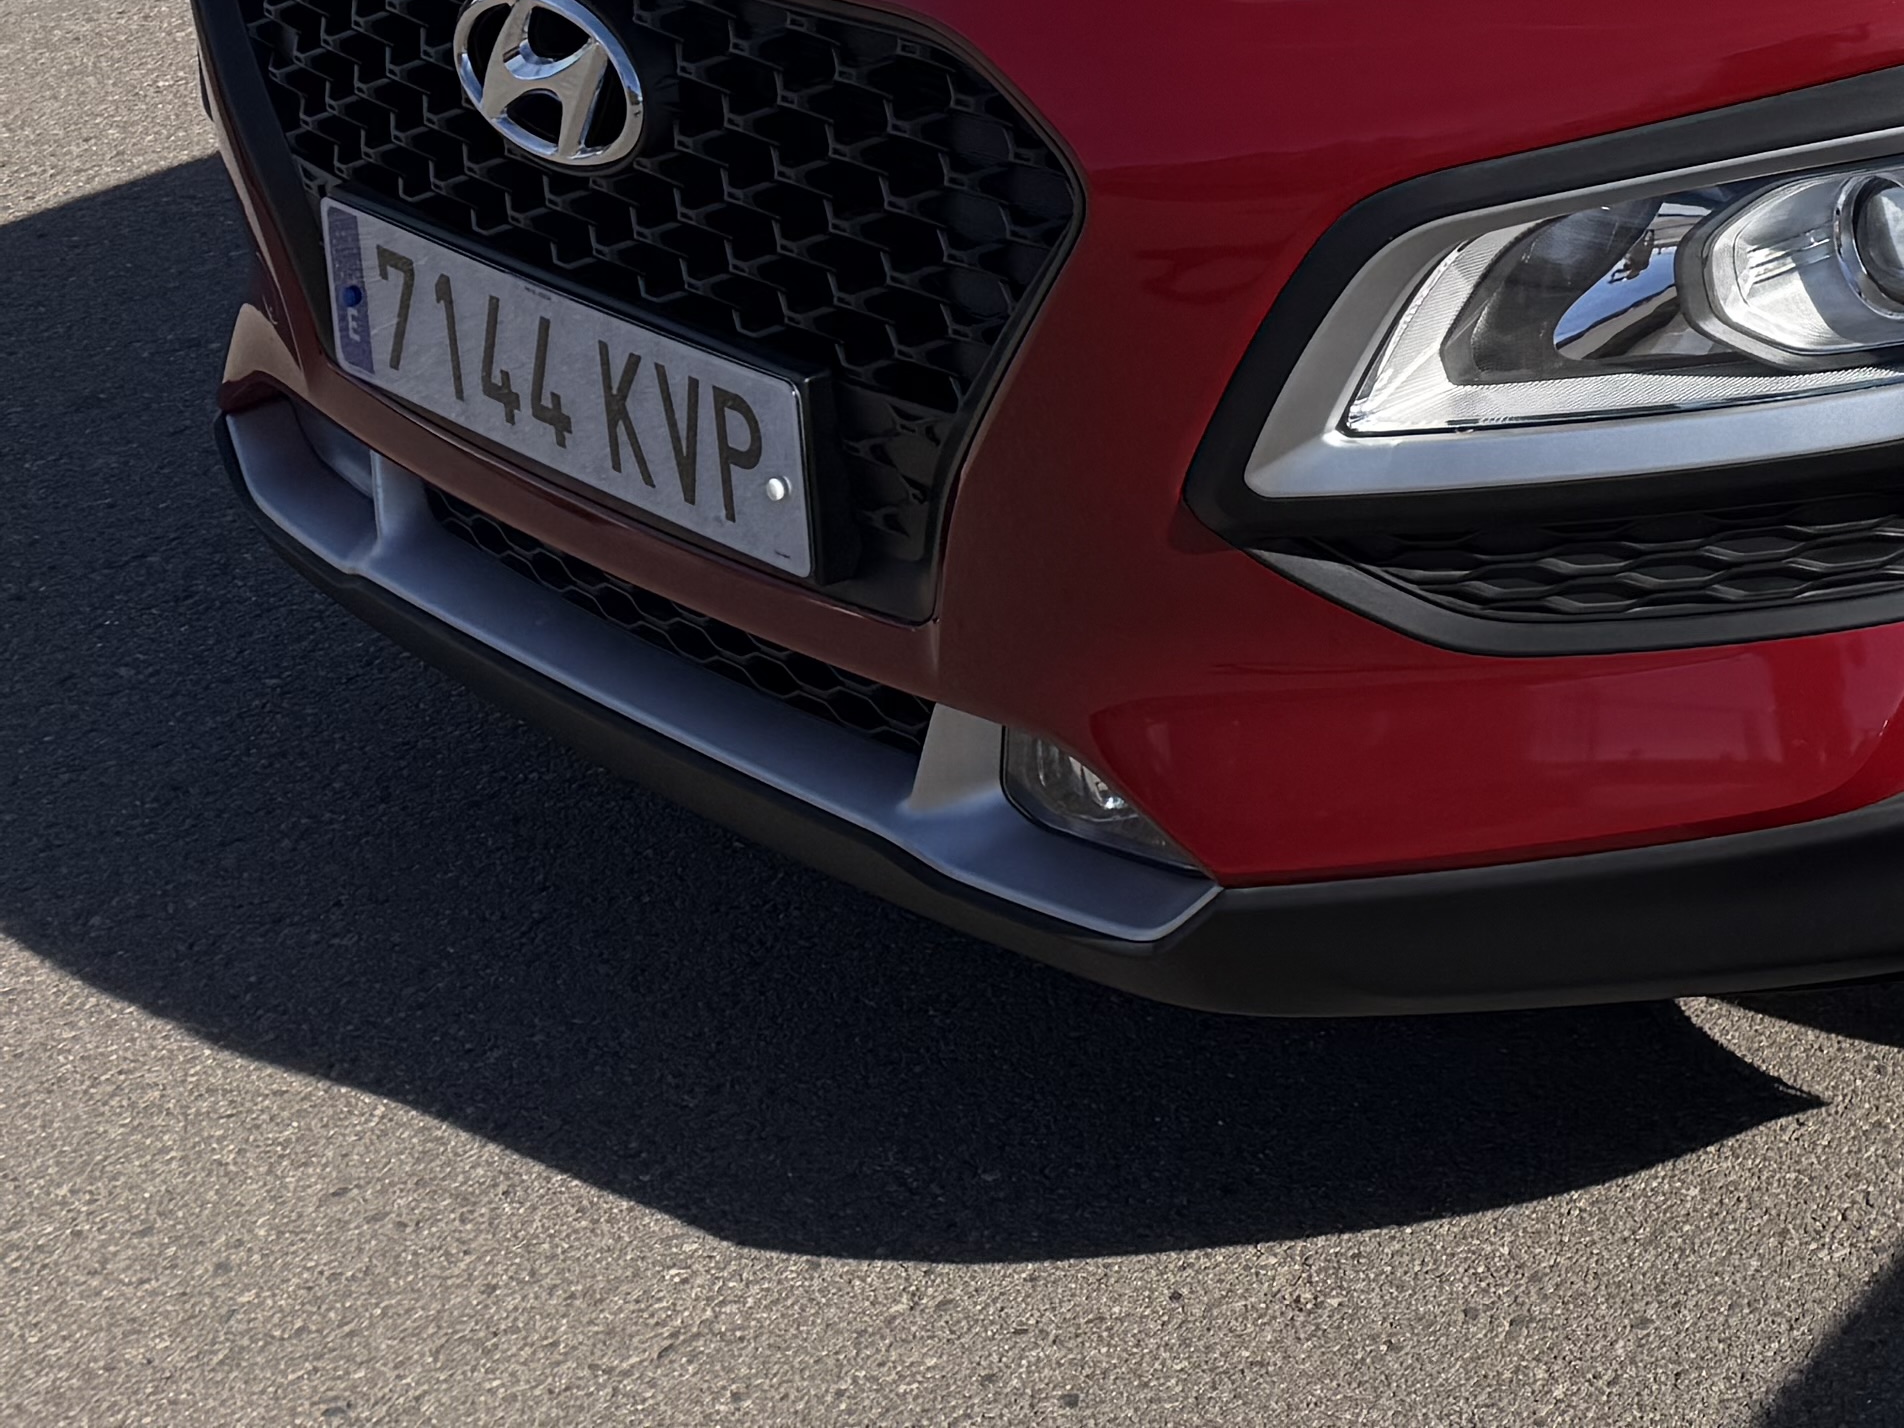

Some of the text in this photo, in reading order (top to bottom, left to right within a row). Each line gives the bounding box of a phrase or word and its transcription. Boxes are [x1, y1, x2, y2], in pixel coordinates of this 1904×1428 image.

[347, 244, 763, 523] E 7144 KVP
